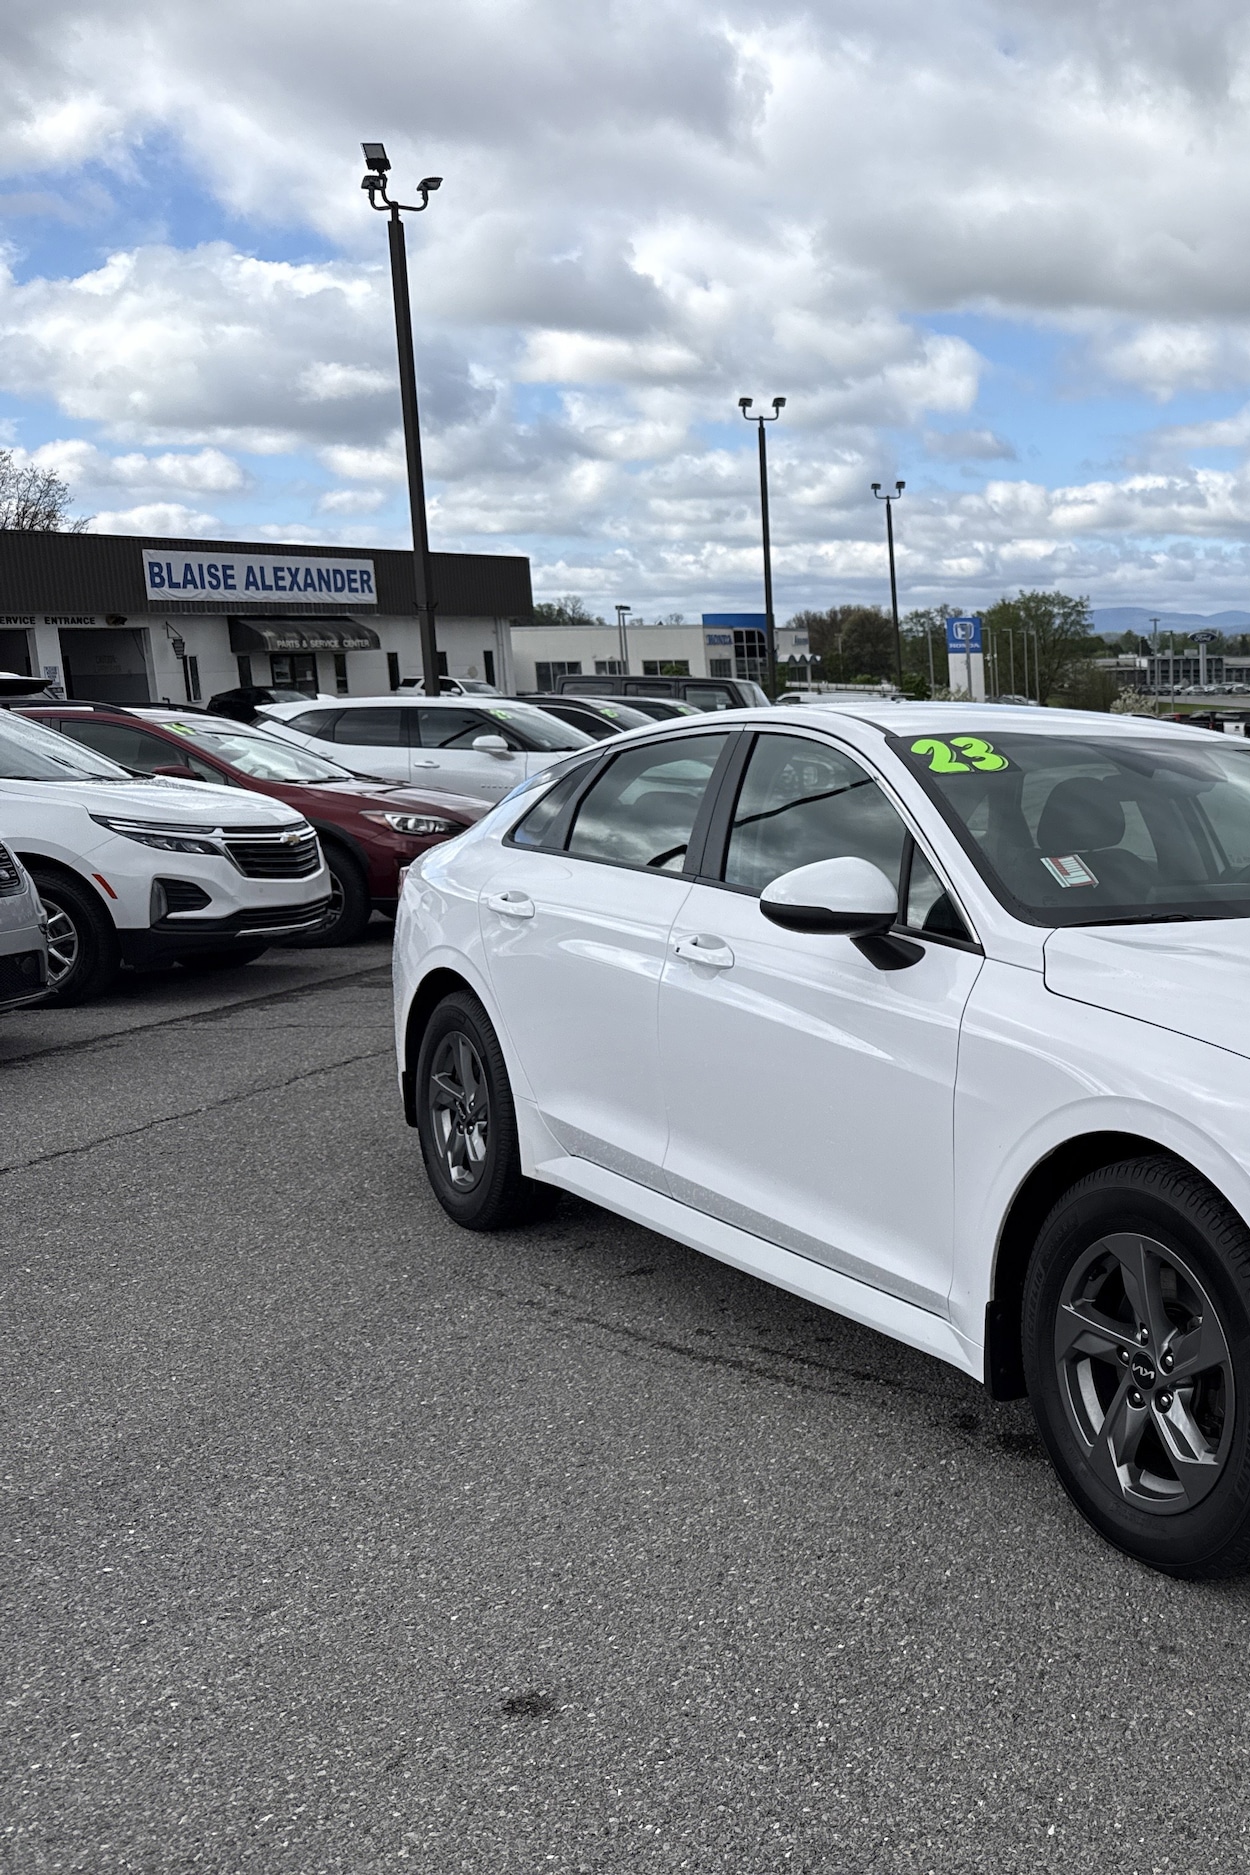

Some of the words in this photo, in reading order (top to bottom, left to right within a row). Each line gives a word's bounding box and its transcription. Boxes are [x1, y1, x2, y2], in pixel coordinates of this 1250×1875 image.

[148, 561, 237, 590] BLAISE
[244, 565, 374, 593] ALEXANDER
[0, 616, 36, 625] ERVICE
[44, 616, 95, 625] ENTRANCE
[277, 640, 300, 649] PARTS
[302, 640, 308, 648] &
[310, 640, 340, 648] SERVICE
[343, 639, 370, 648] CENTER
[910, 736, 1009, 774] 23
